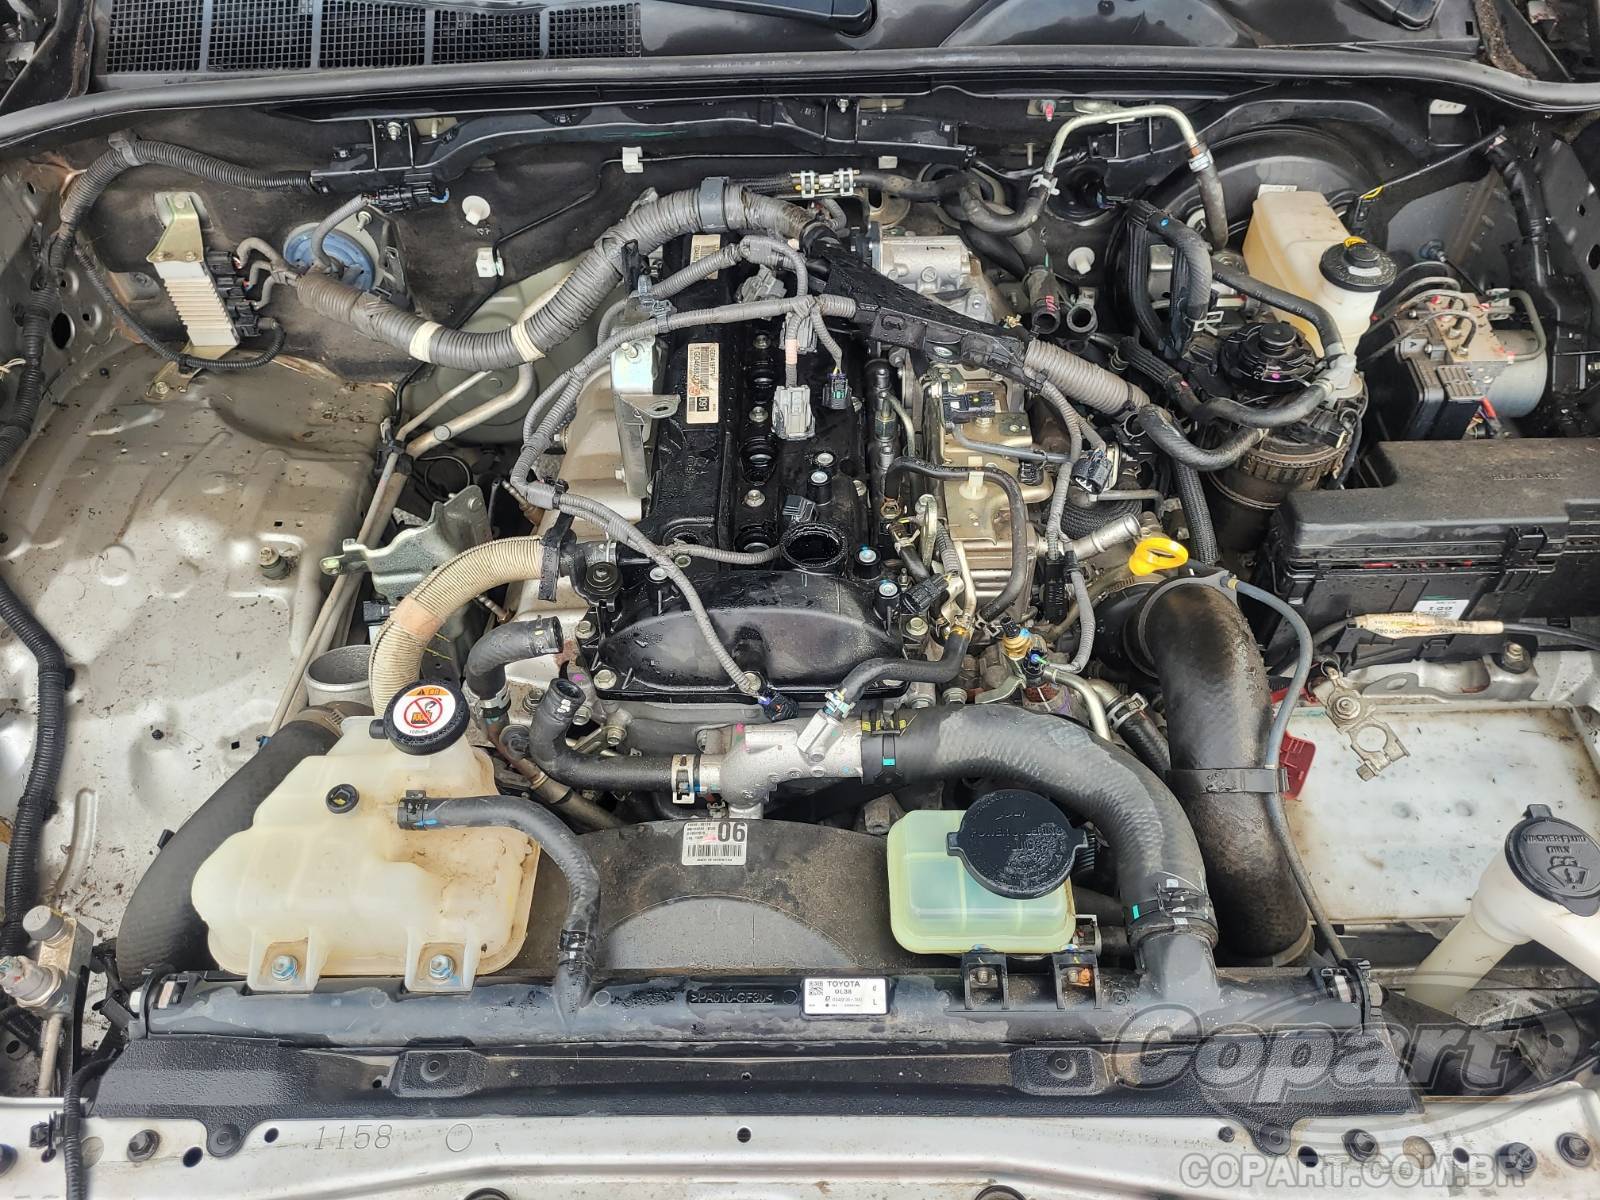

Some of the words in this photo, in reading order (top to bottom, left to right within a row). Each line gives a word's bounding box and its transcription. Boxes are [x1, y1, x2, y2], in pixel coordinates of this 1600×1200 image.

[717, 822, 746, 842] 06
[827, 980, 861, 988] TOYOTA
[313, 1124, 393, 1150] 1158
